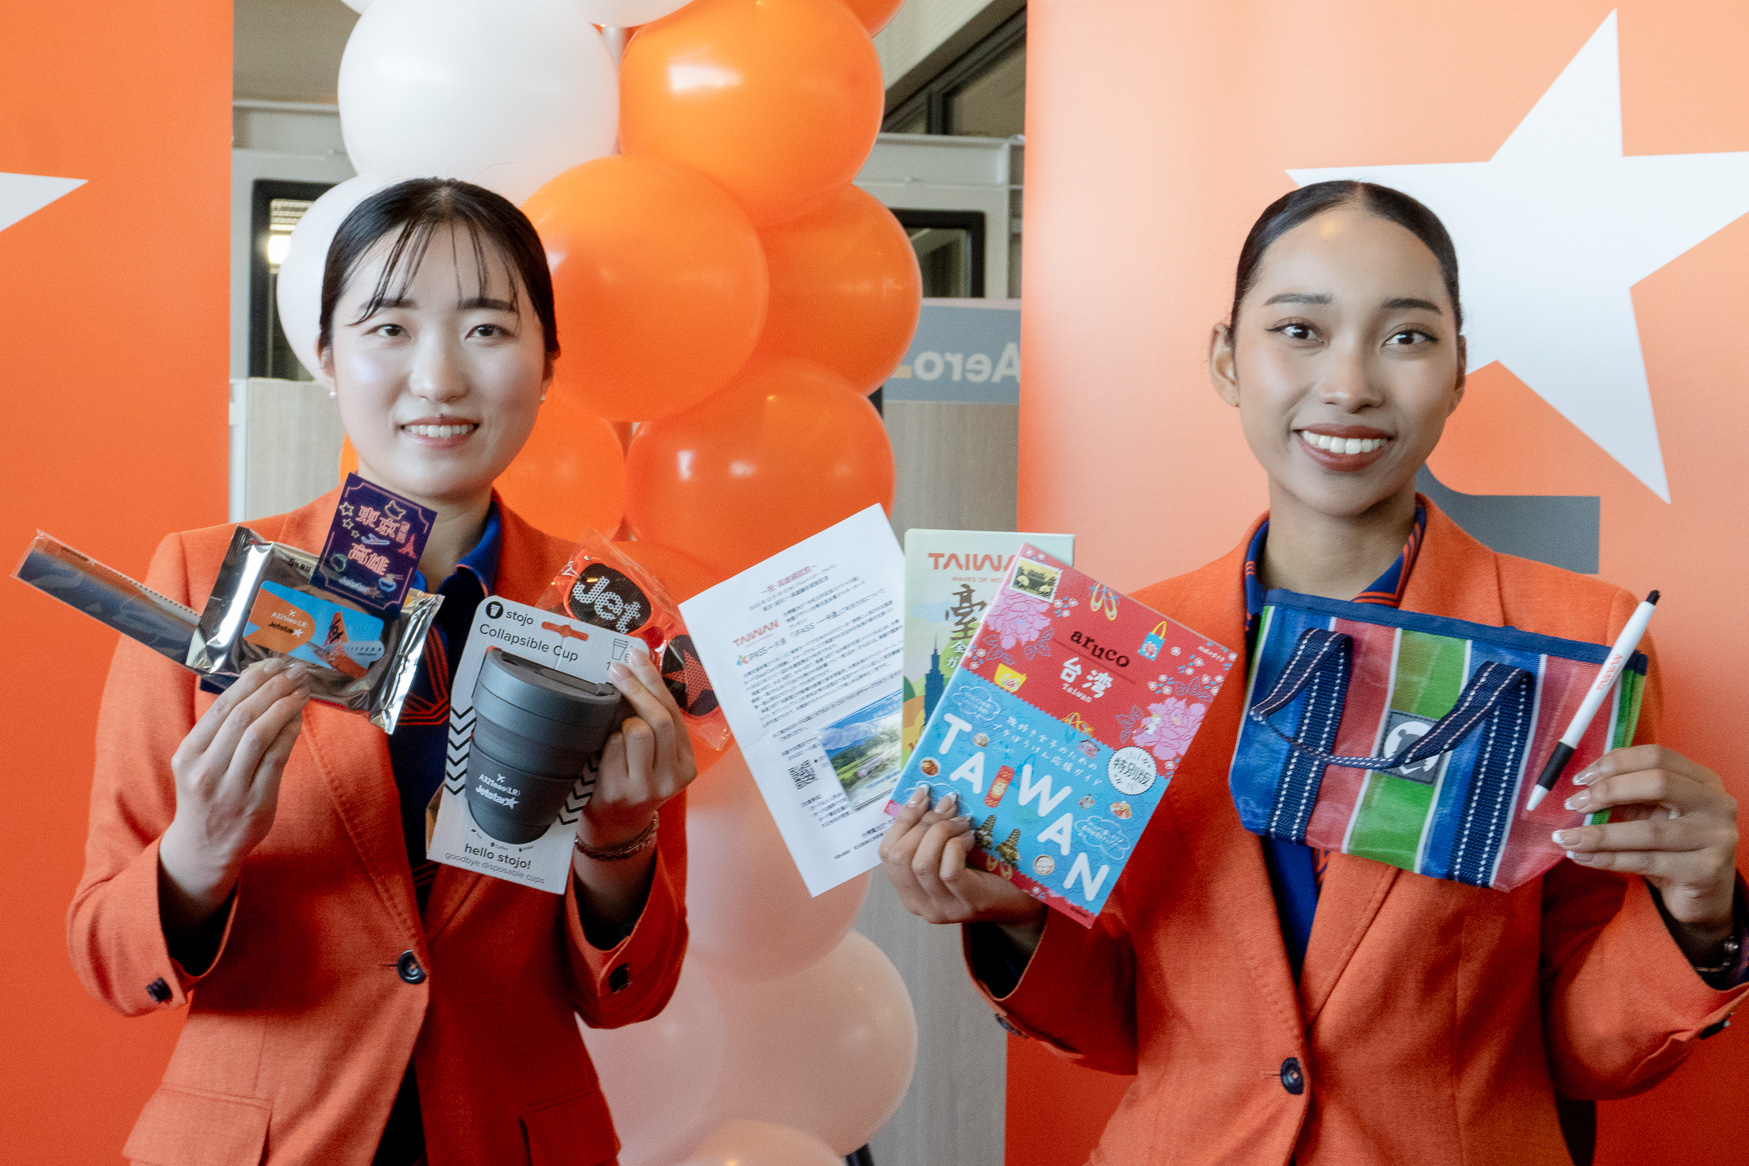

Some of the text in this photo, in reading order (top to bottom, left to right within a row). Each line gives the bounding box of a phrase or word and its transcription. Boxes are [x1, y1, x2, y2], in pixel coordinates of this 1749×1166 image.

[928, 552, 1017, 572] TAIWA
[505, 608, 535, 627] stojo
[573, 576, 641, 635] Jet
[479, 623, 579, 663] Collapsible Cup
[1070, 630, 1130, 668] aruco
[1060, 656, 1114, 699] 台湾
[479, 773, 521, 797] A321neo(LR)
[1113, 757, 1152, 786] 特別版
[475, 784, 508, 806] Jetstar
[444, 851, 545, 885] goodbye disposable cups
[464, 842, 532, 870] hello stojo!
